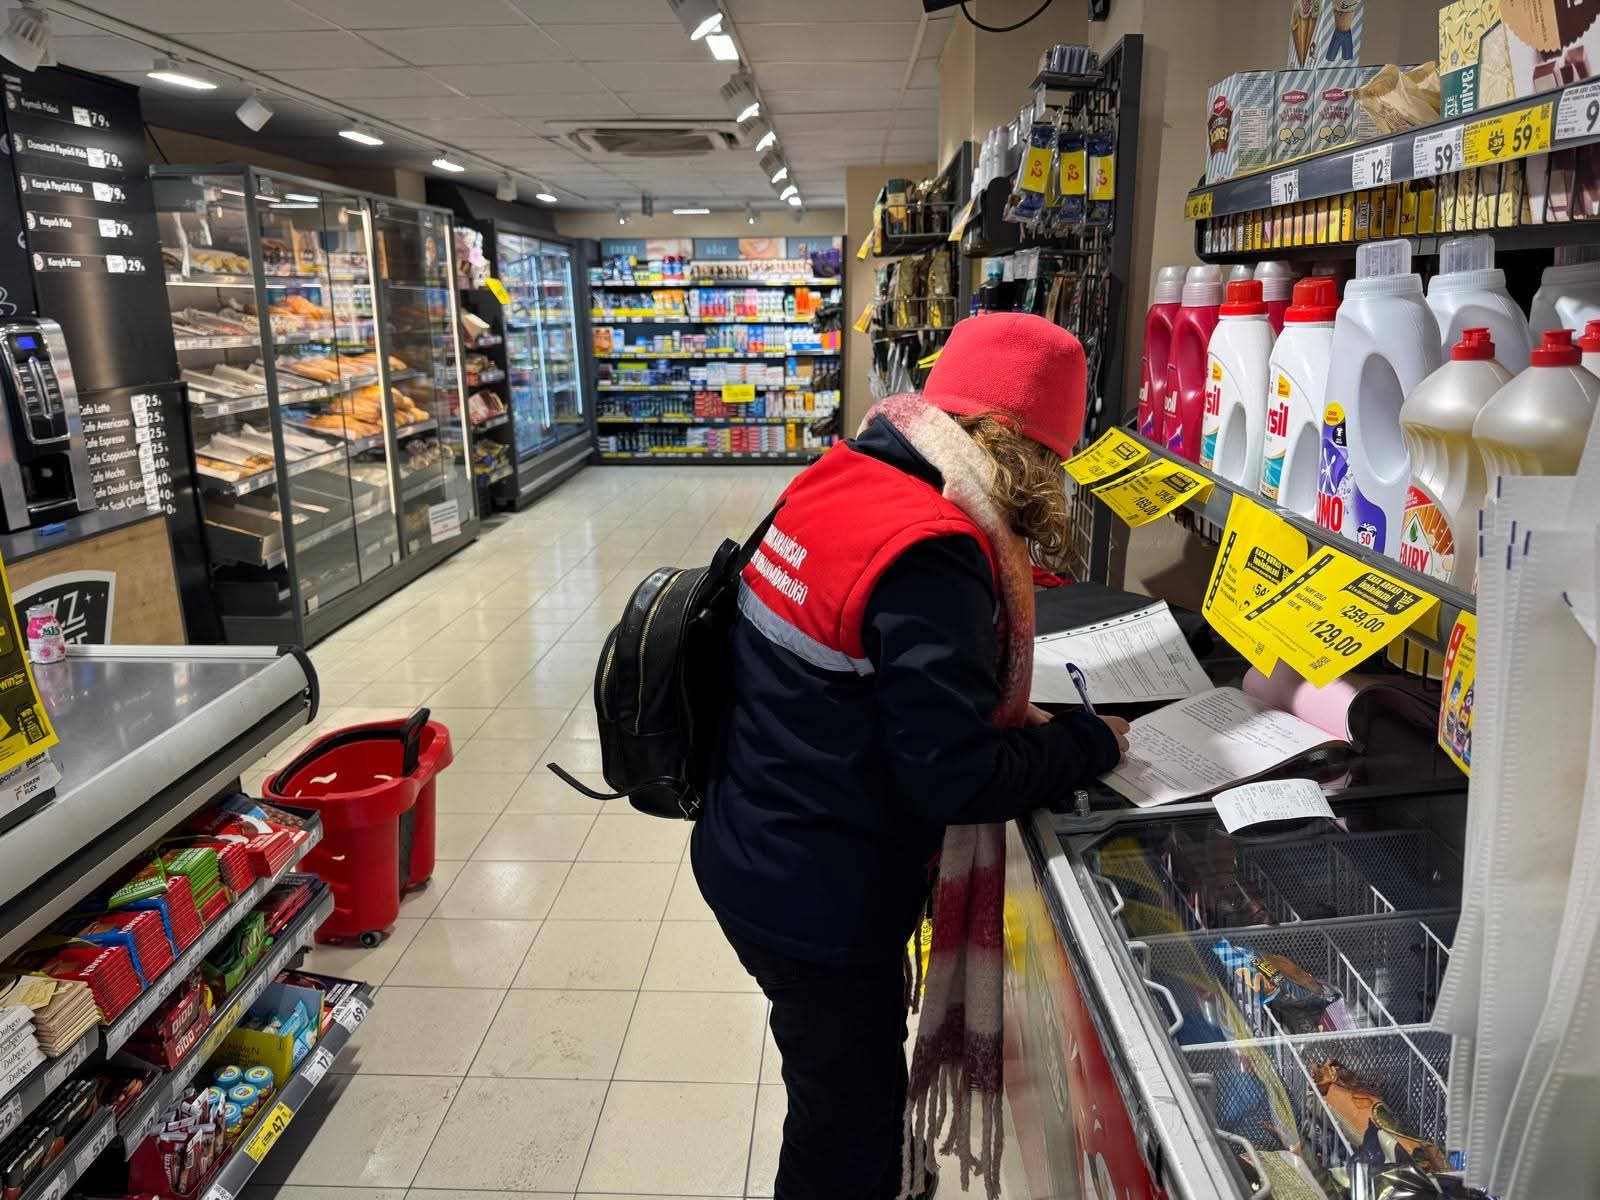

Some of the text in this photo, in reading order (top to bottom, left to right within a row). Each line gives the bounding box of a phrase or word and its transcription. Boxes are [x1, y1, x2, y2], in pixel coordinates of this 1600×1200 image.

[1512, 124, 1532, 153] 59
[1434, 144, 1453, 174] 59
[1371, 159, 1384, 185] 12
[94, 403, 111, 414] Latte
[97, 418, 130, 431] Americano
[99, 435, 126, 447] Espresso
[105, 466, 126, 480] Mocha
[107, 482, 129, 496] Double
[1361, 532, 1372, 546] 50
[23, 775, 41, 790] TOKEN
[24, 784, 38, 796] FLEX
[352, 1007, 365, 1022] 69
[317, 1055, 330, 1070] 17
[271, 1116, 285, 1134] 47
